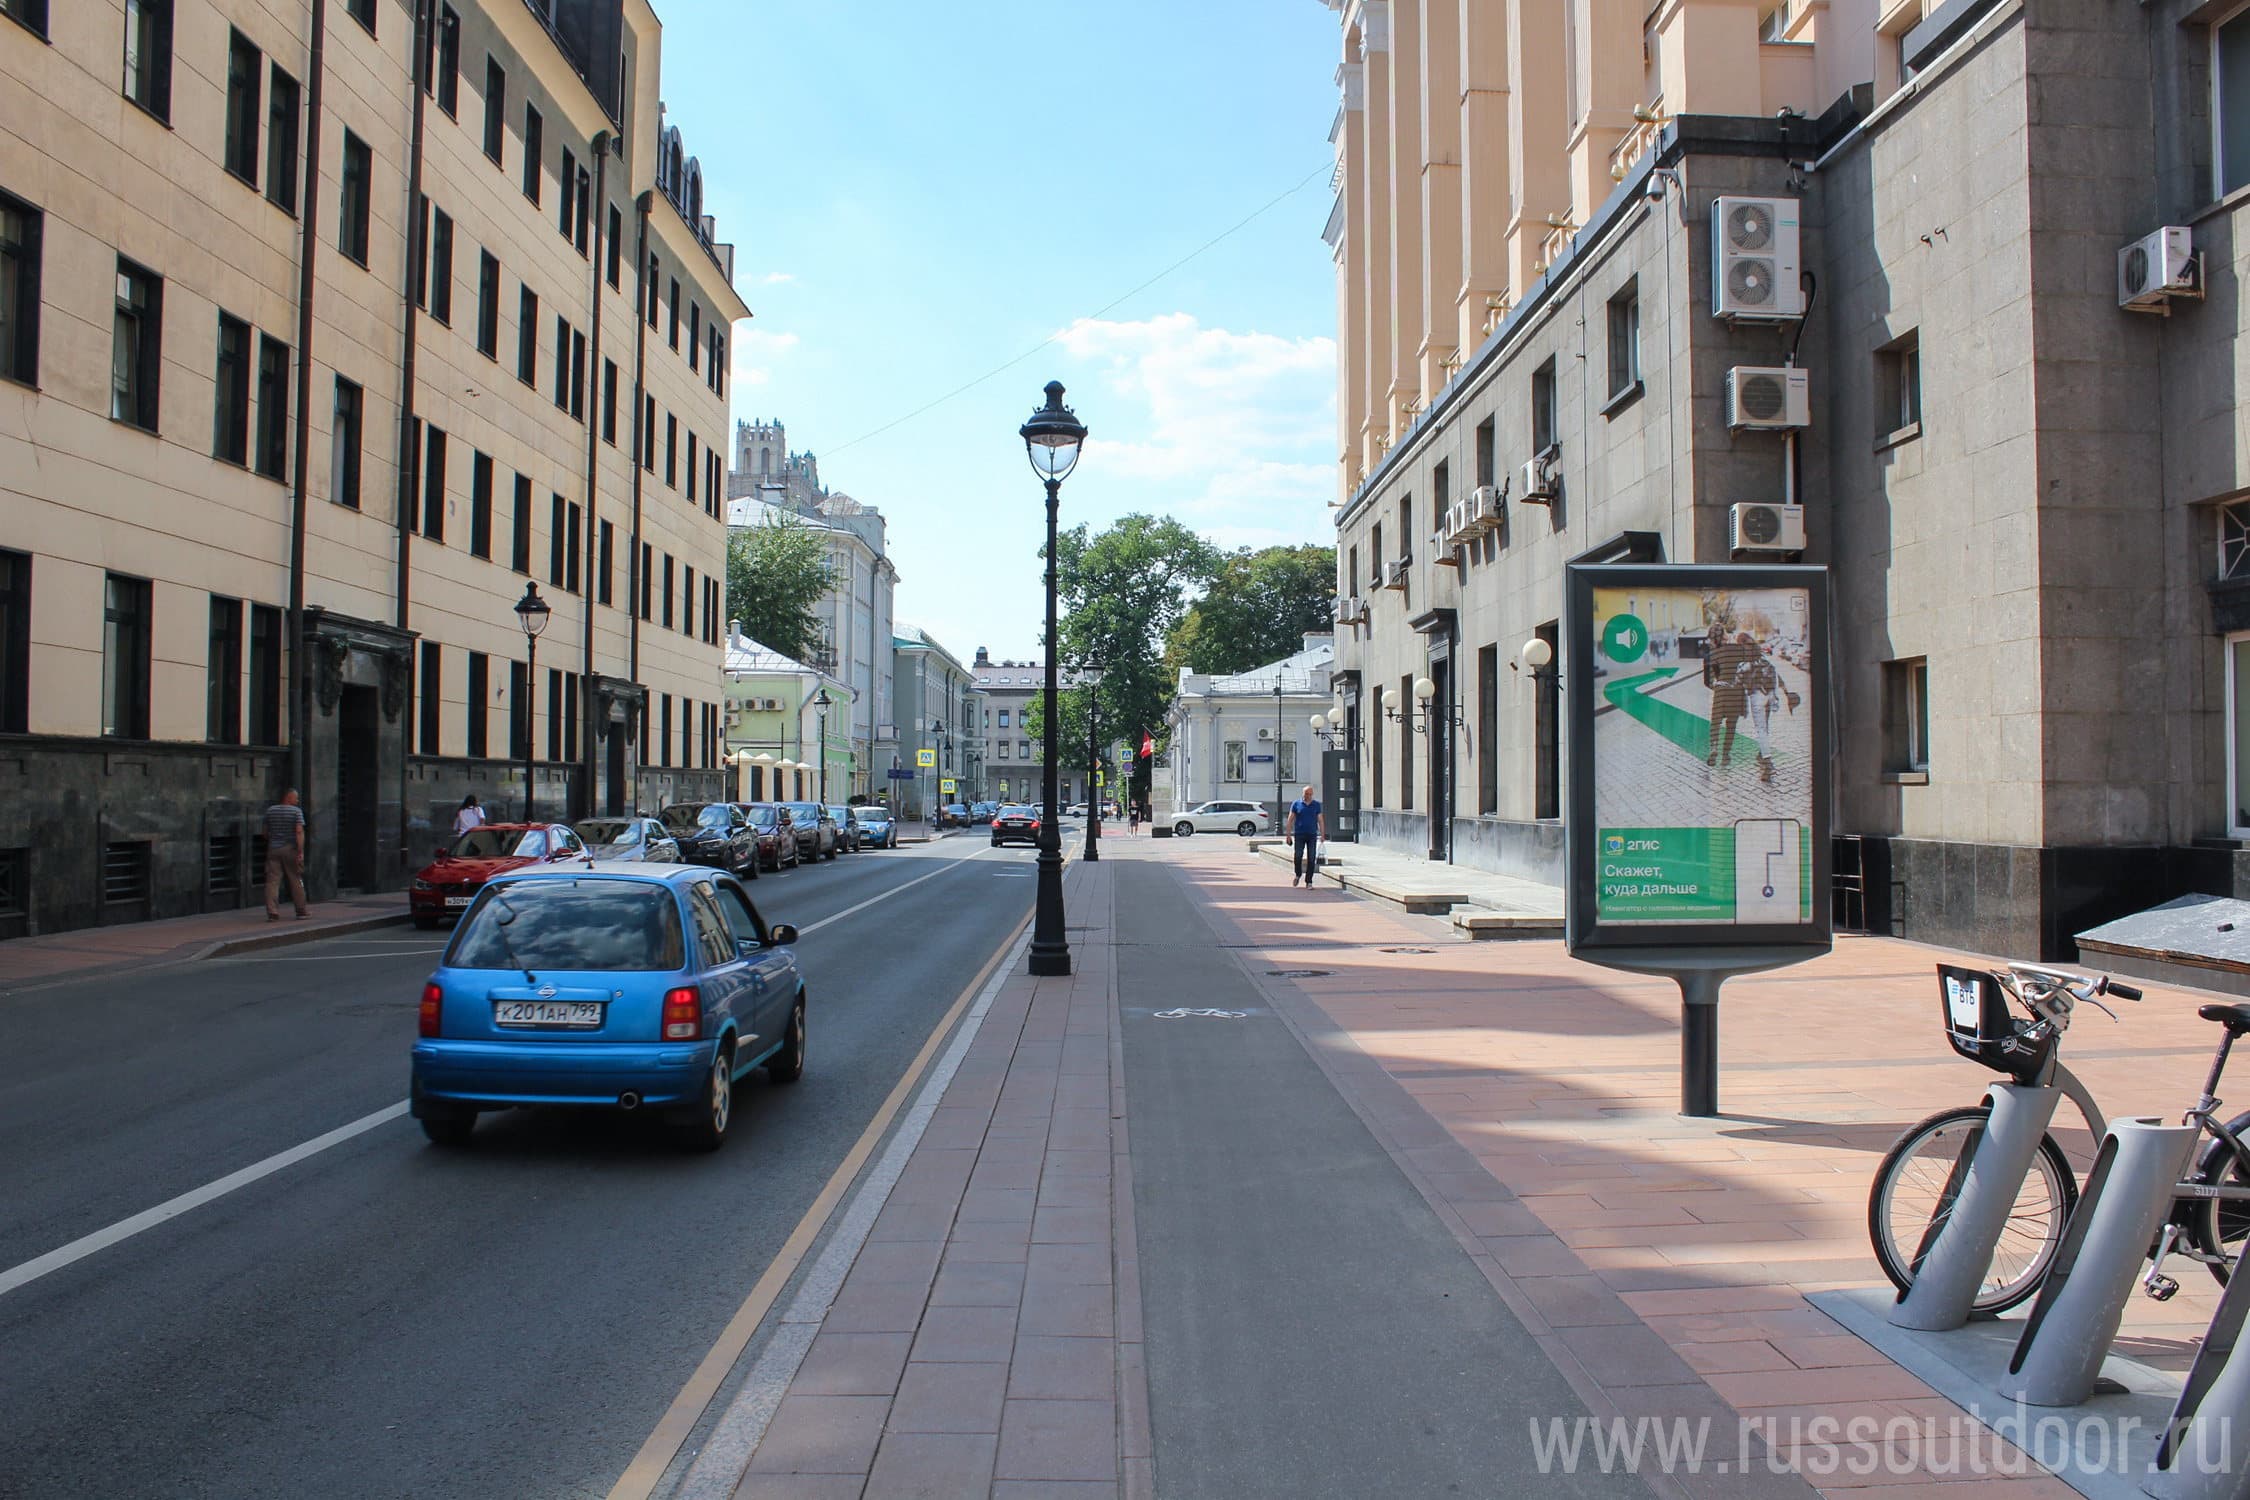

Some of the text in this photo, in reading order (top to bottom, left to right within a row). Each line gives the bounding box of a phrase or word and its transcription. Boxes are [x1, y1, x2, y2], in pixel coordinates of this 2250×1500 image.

[1627, 840, 1660, 851] 2ГИС
[1605, 864, 1663, 878] Скажет,
[1605, 883, 1697, 896] куда дальше
[1959, 988, 1975, 1005] ВТБ
[502, 1003, 596, 1020] К201АН 799
